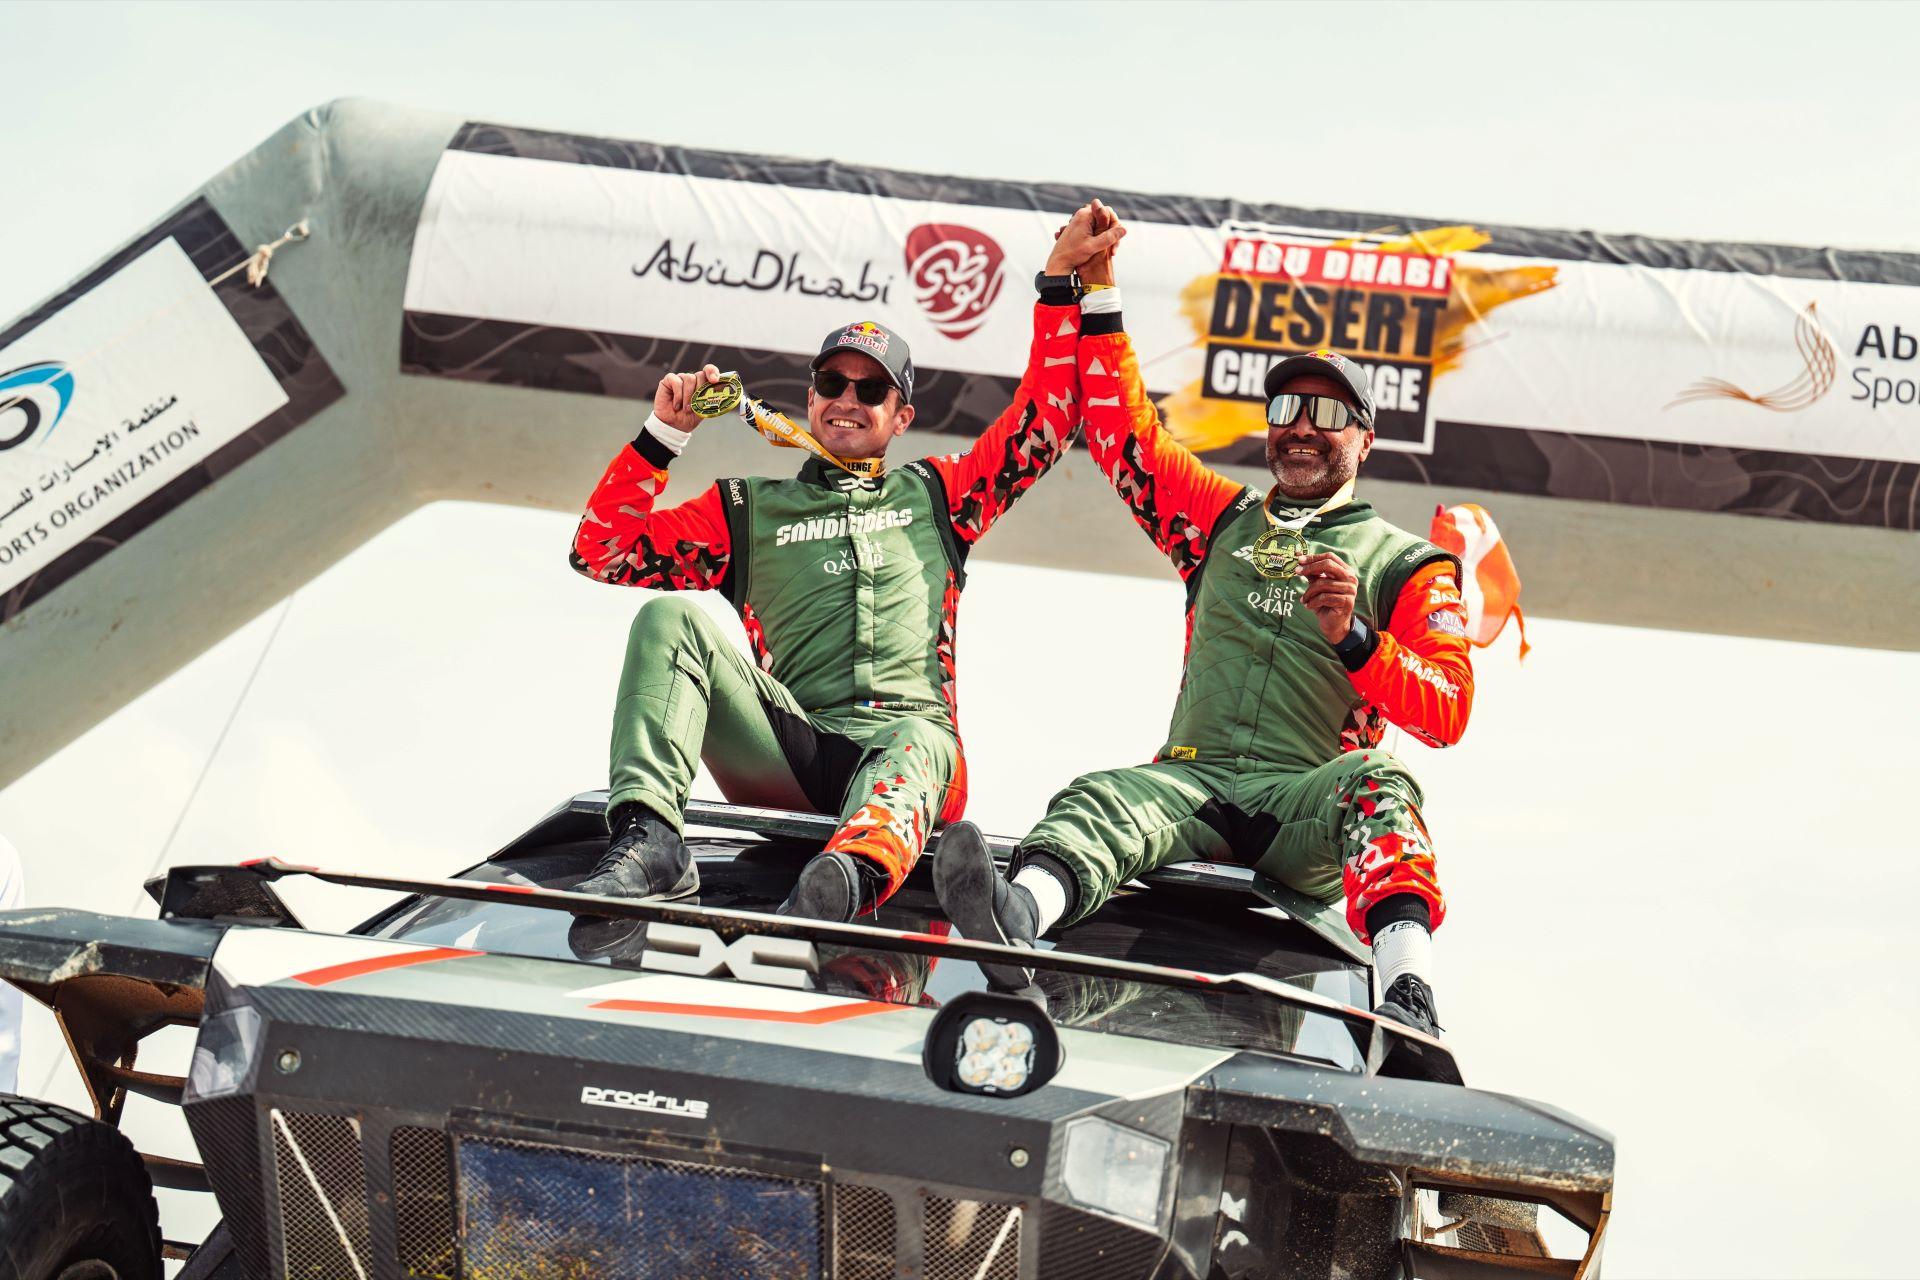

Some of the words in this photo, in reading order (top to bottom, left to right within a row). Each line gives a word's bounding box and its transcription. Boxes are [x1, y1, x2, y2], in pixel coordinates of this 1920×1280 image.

[1229, 239, 1313, 277] ABU
[1321, 249, 1450, 290] DHABI
[1210, 278, 1448, 358] DESERT
[838, 335, 862, 346] Red
[862, 337, 888, 355] Bull
[1850, 367, 1920, 409] Spo
[50, 419, 200, 530] ORGANIZATION
[727, 477, 745, 507] Sabelt
[1235, 489, 1262, 511] Sabelt
[1247, 591, 1294, 617] QATAR
[1266, 583, 1297, 602] isit
